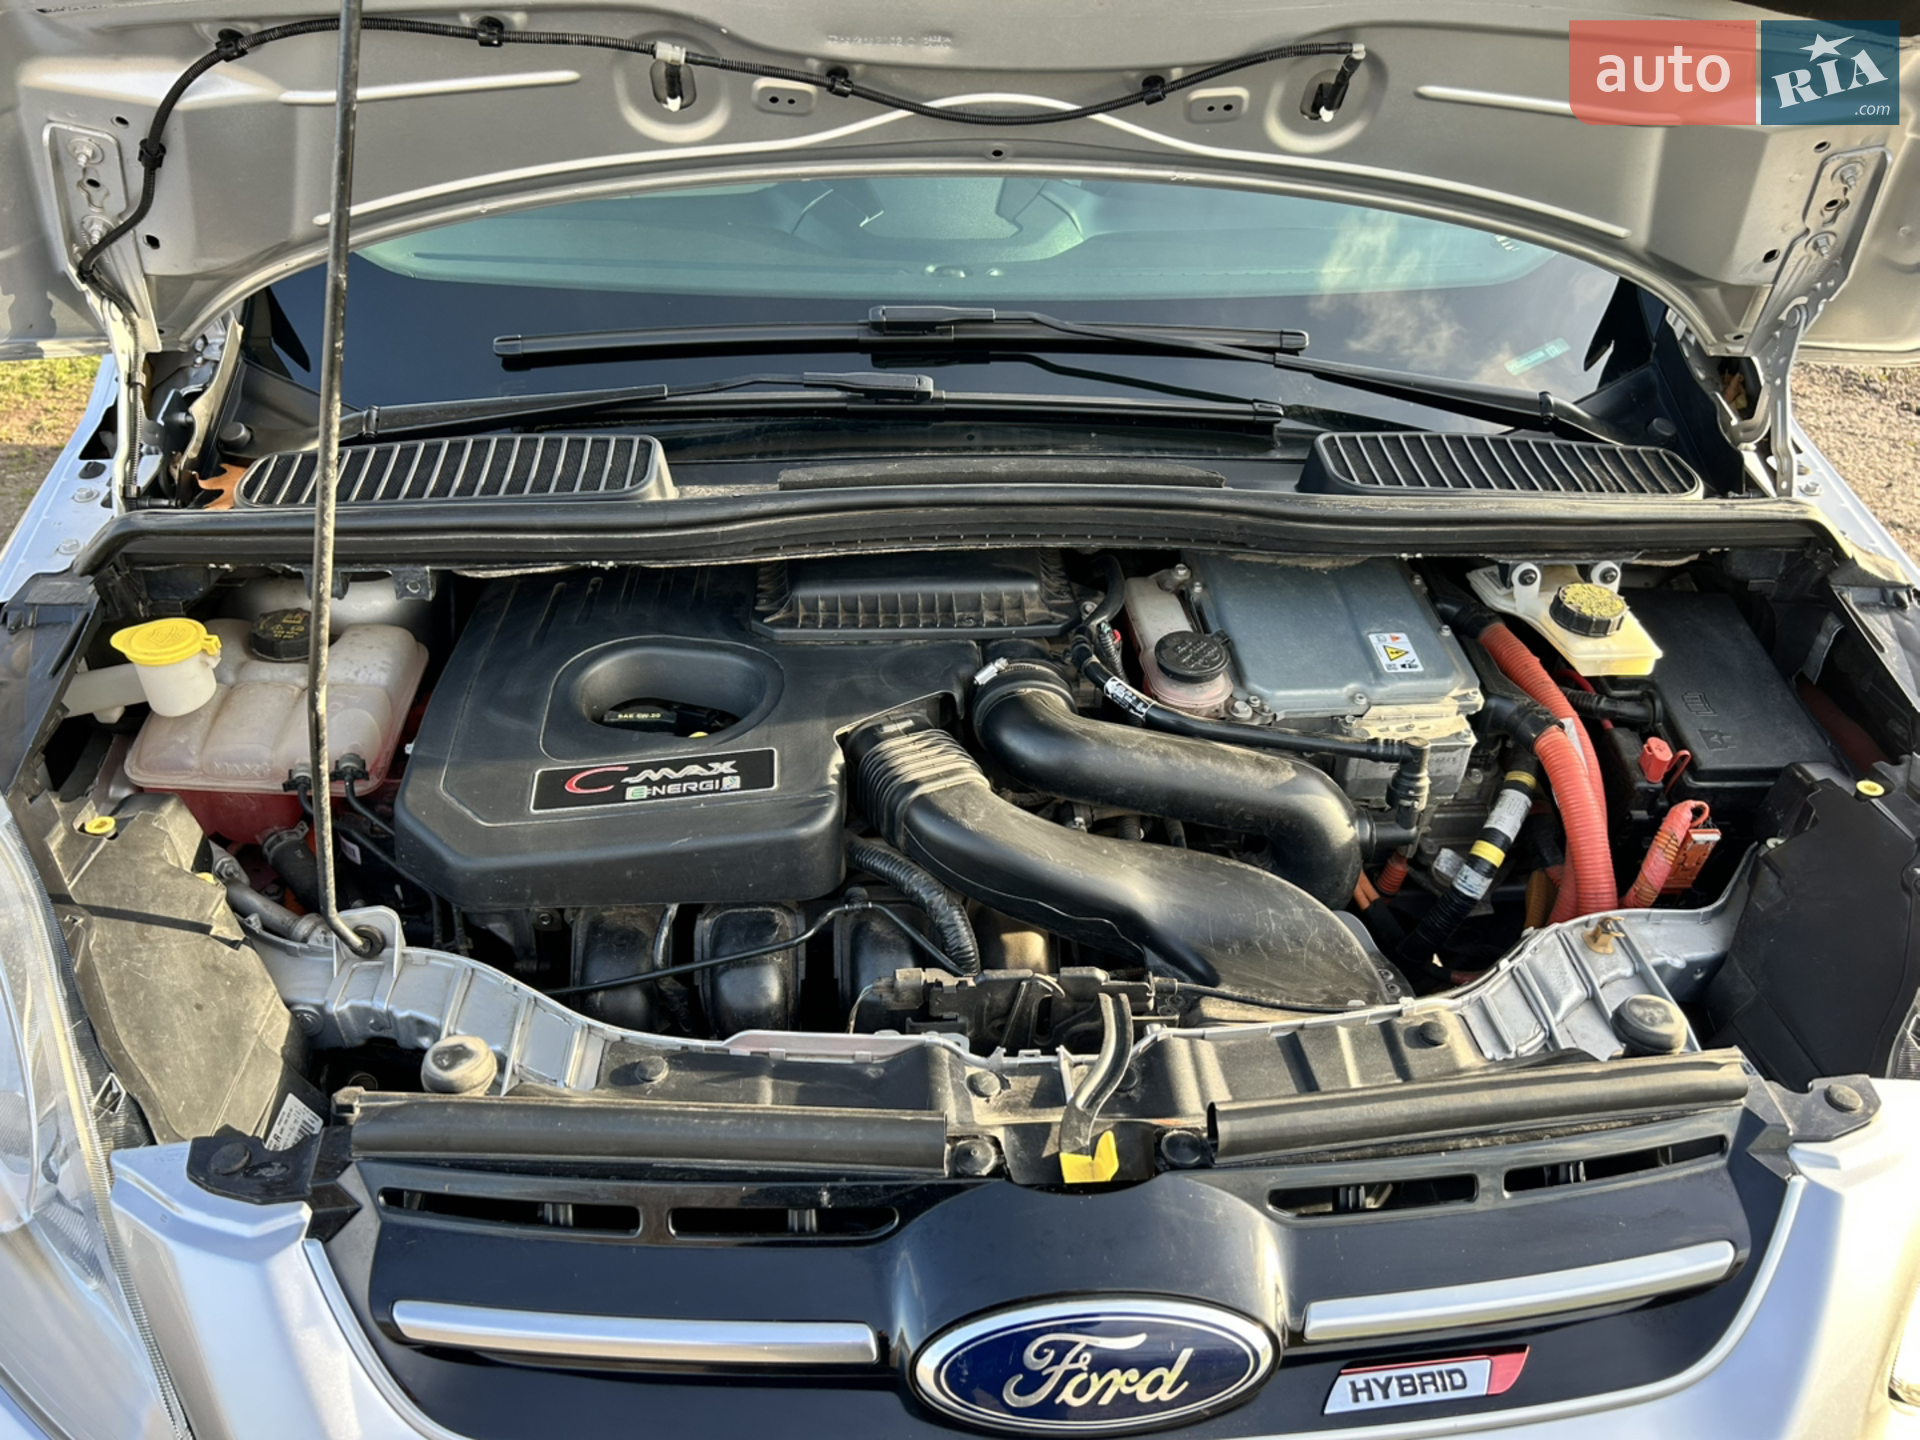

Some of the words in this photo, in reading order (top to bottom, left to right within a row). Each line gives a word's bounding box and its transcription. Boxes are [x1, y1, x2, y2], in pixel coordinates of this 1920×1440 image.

[625, 782, 723, 801] ENERGI
[1002, 1332, 1196, 1408] Ford
[1348, 1367, 1468, 1404] HYBRID
